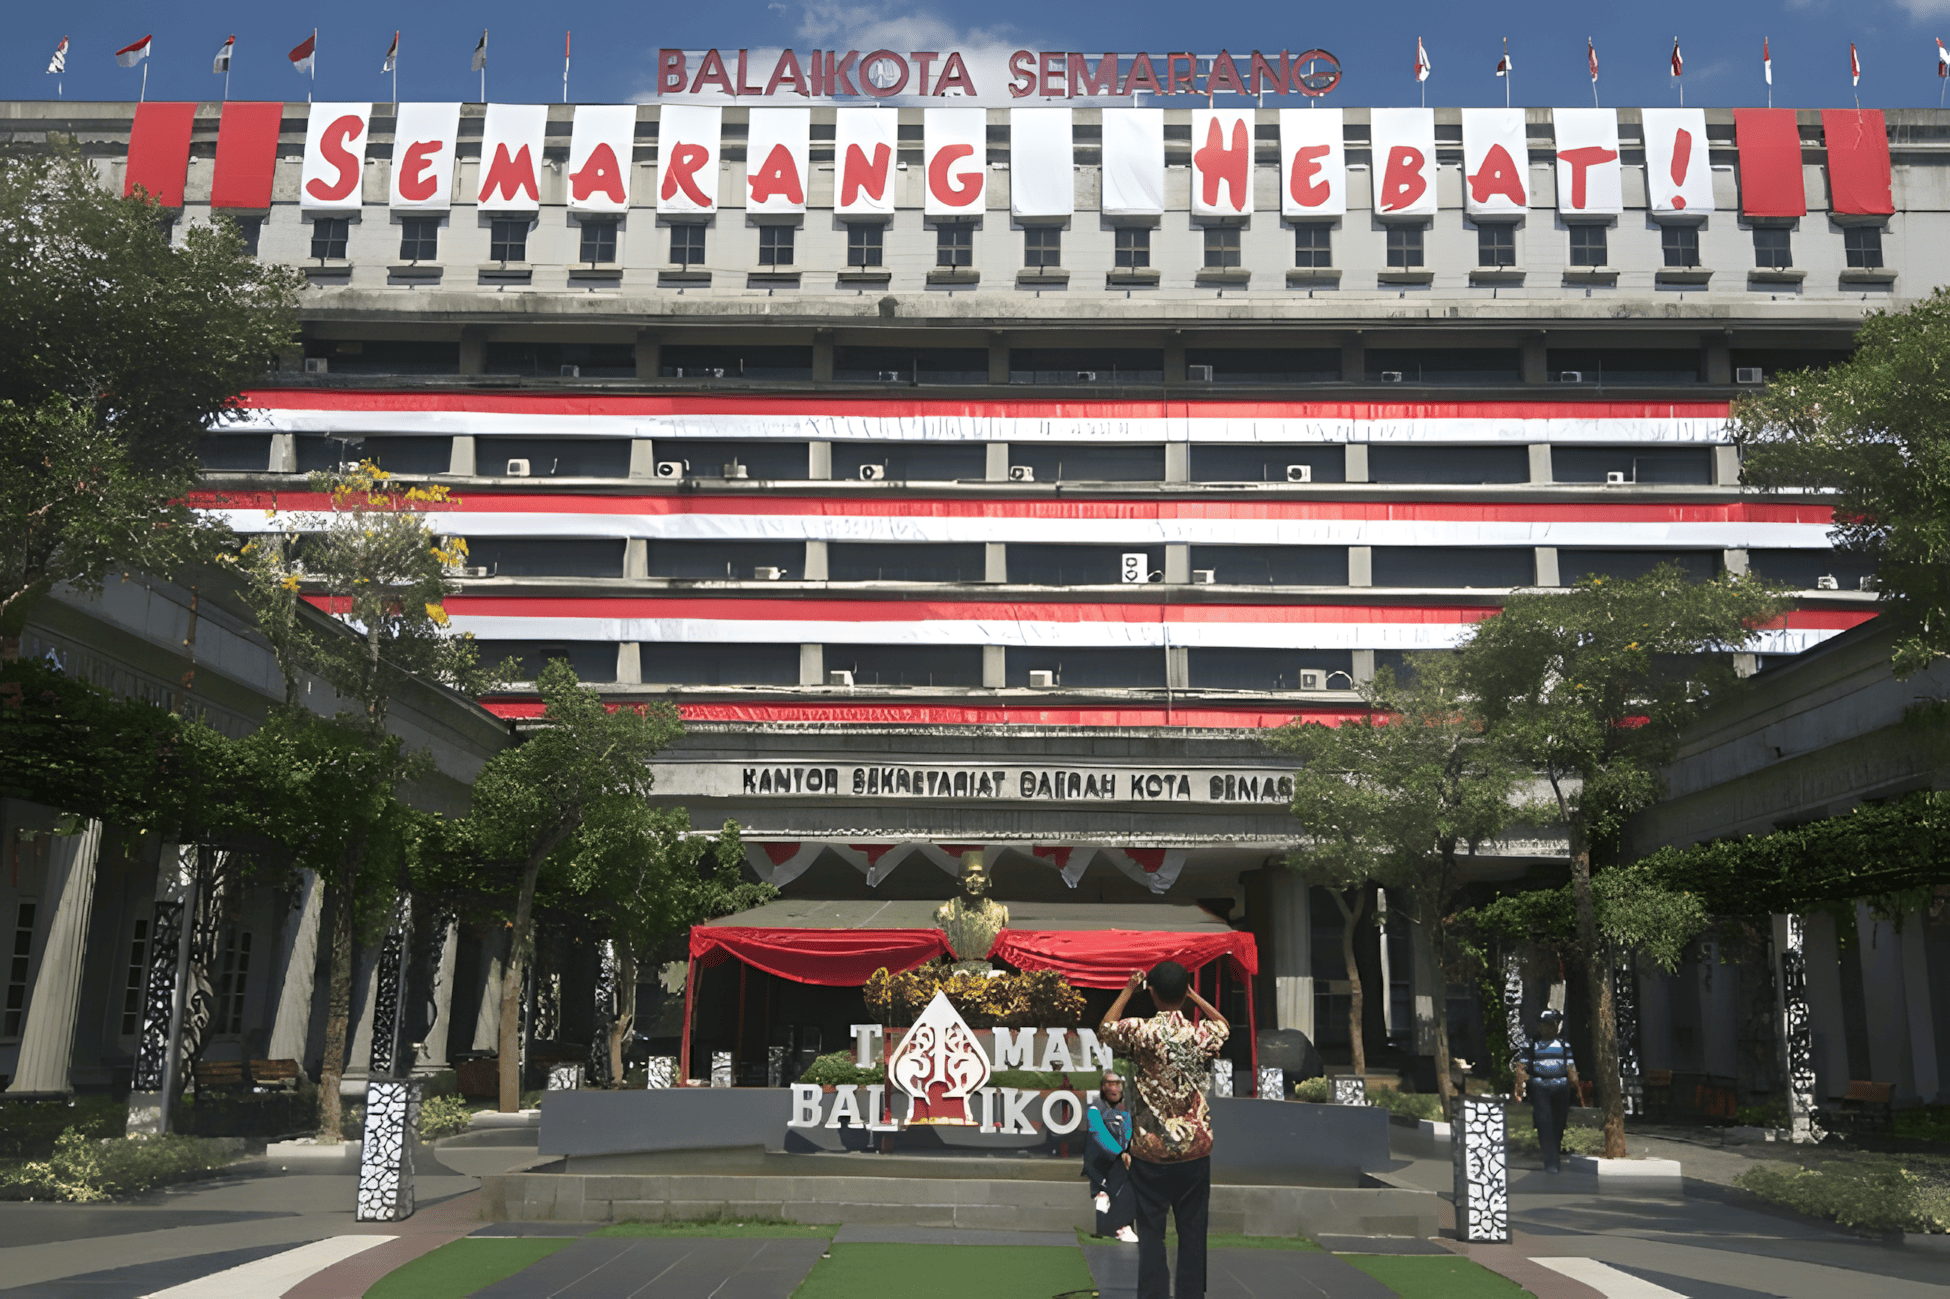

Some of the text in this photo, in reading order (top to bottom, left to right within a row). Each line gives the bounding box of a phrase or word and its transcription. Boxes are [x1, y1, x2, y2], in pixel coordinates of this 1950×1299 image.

[658, 49, 1343, 99] BALAIKOTA SEMARANG
[305, 115, 1708, 212] SEMARANG HEBAT!
[1131, 774, 1191, 800] KOTA
